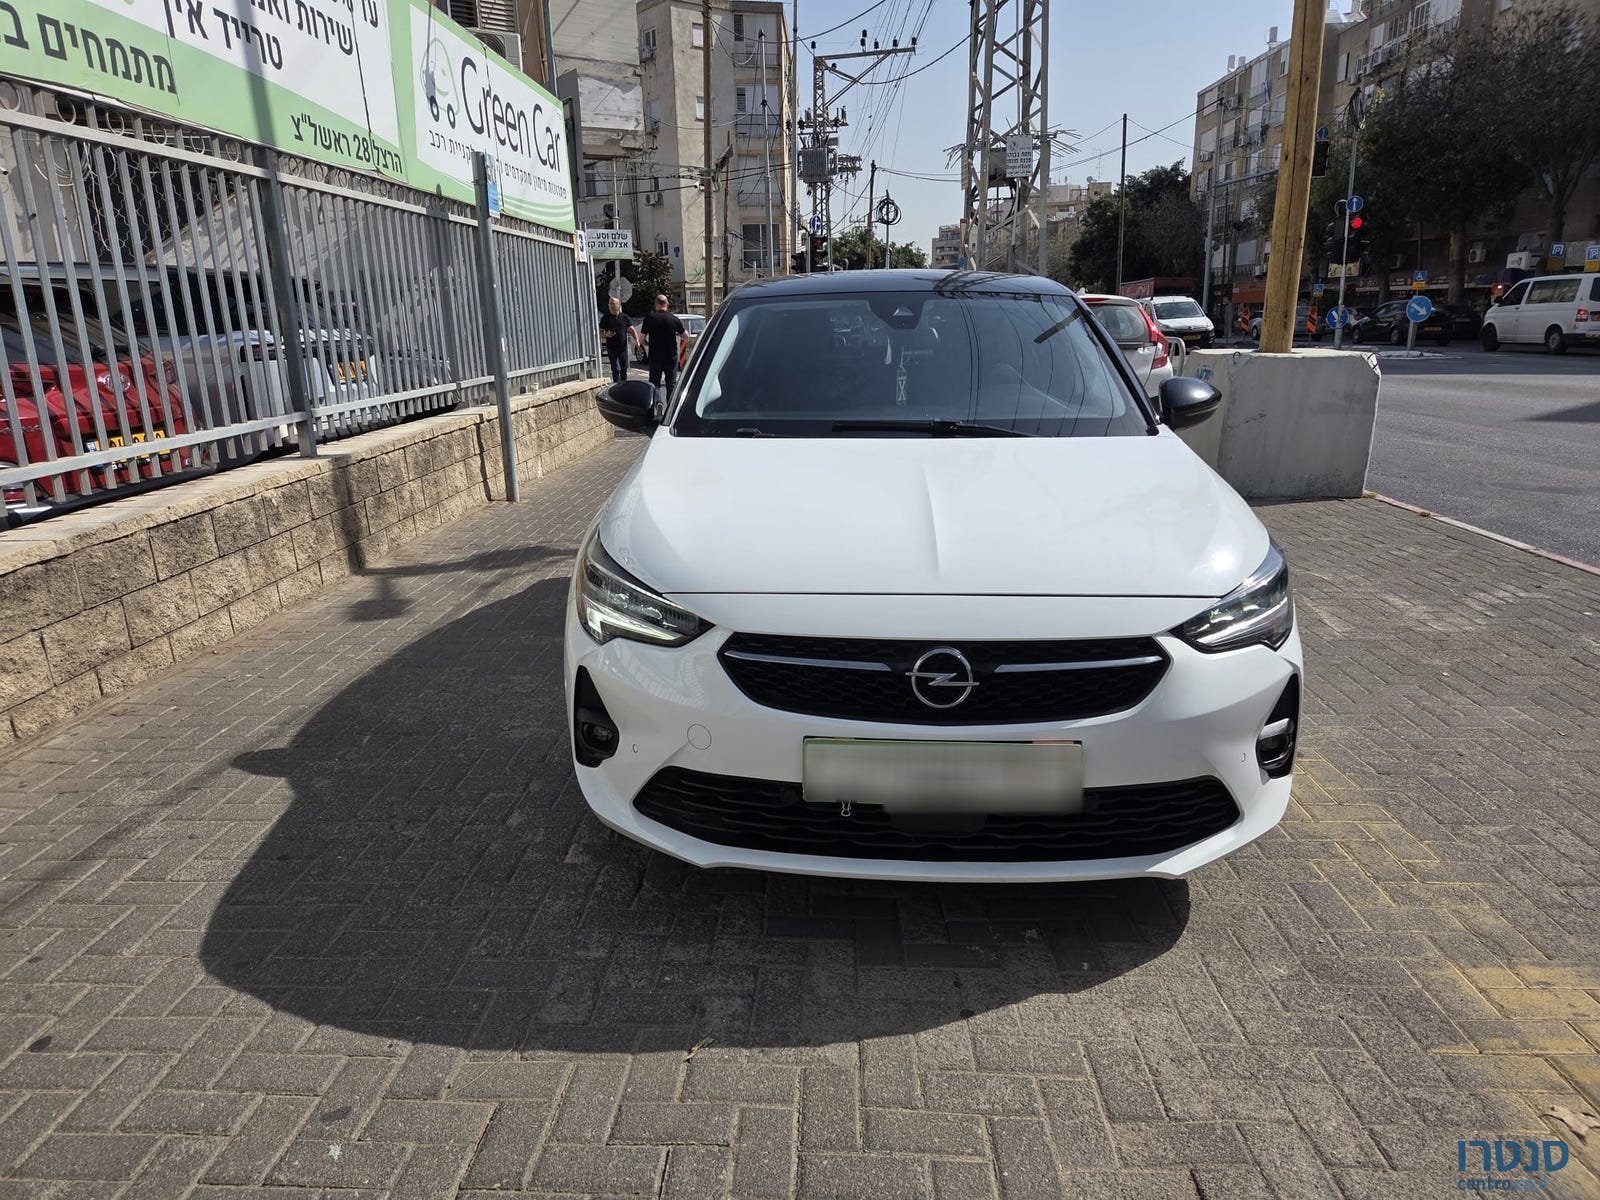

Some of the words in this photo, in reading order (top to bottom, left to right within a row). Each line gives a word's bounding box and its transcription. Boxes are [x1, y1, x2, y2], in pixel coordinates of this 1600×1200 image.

[0, 4, 30, 50] ב
[212, 7, 283, 70] טרייד
[295, 0, 353, 55] שירות
[36, 13, 177, 94] מתמחים
[461, 56, 532, 158] Green
[533, 103, 561, 172] Car
[353, 134, 370, 163] 28
[372, 139, 402, 174] הרצל
[429, 130, 447, 151] רכב
[607, 240, 628, 248] אצלנו
[612, 231, 628, 240] שלם
